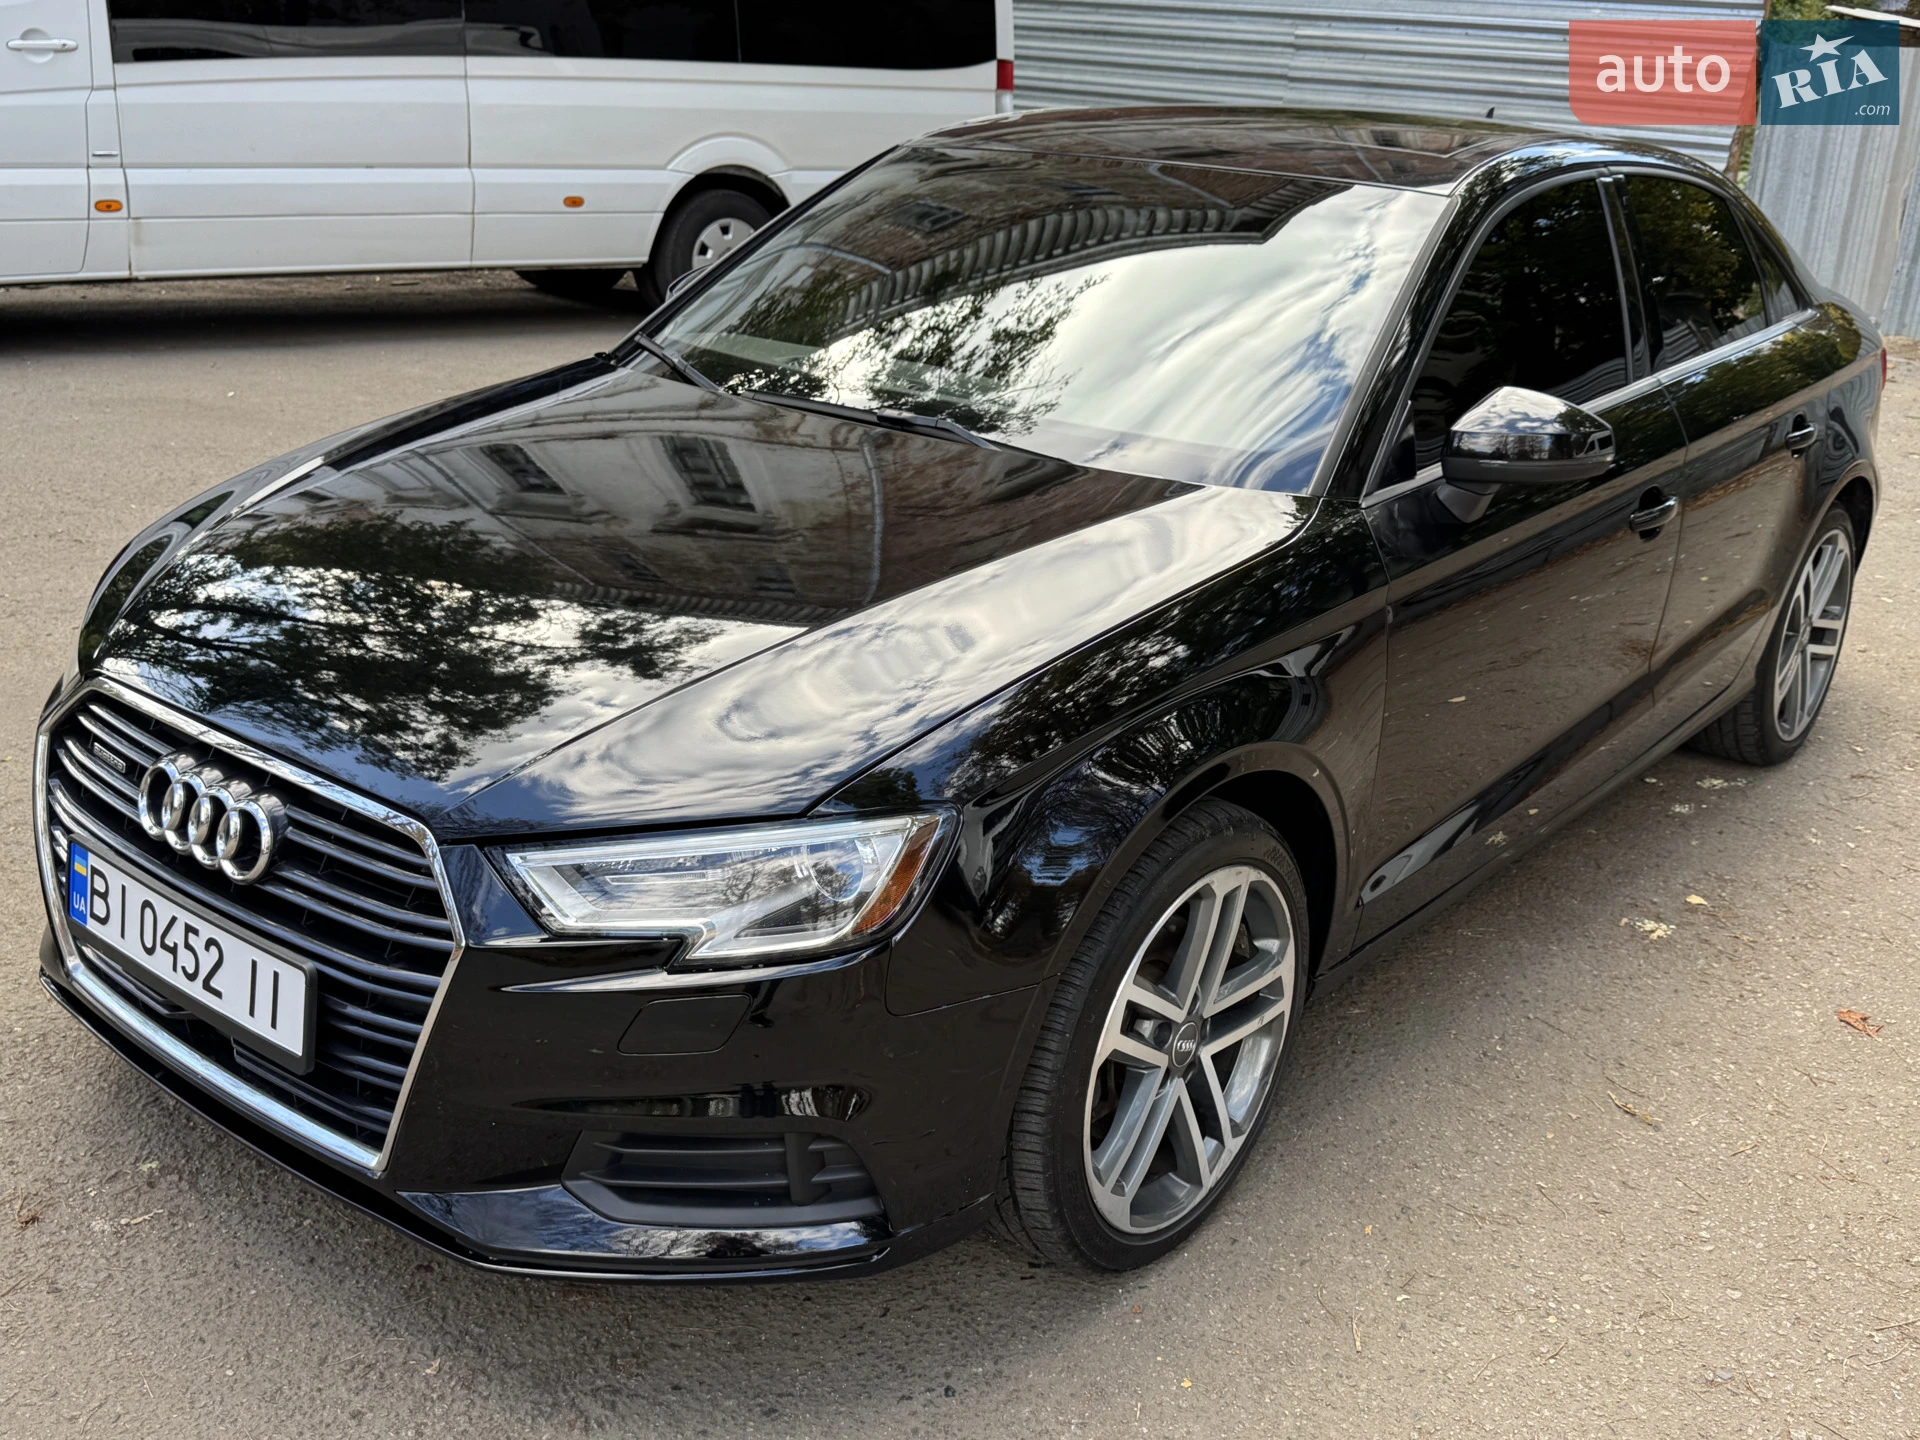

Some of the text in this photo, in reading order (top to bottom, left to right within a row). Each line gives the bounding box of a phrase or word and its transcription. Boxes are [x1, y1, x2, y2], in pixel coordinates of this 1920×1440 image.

[73, 893, 86, 915] UA
[89, 864, 280, 1030] BI 0452 II
